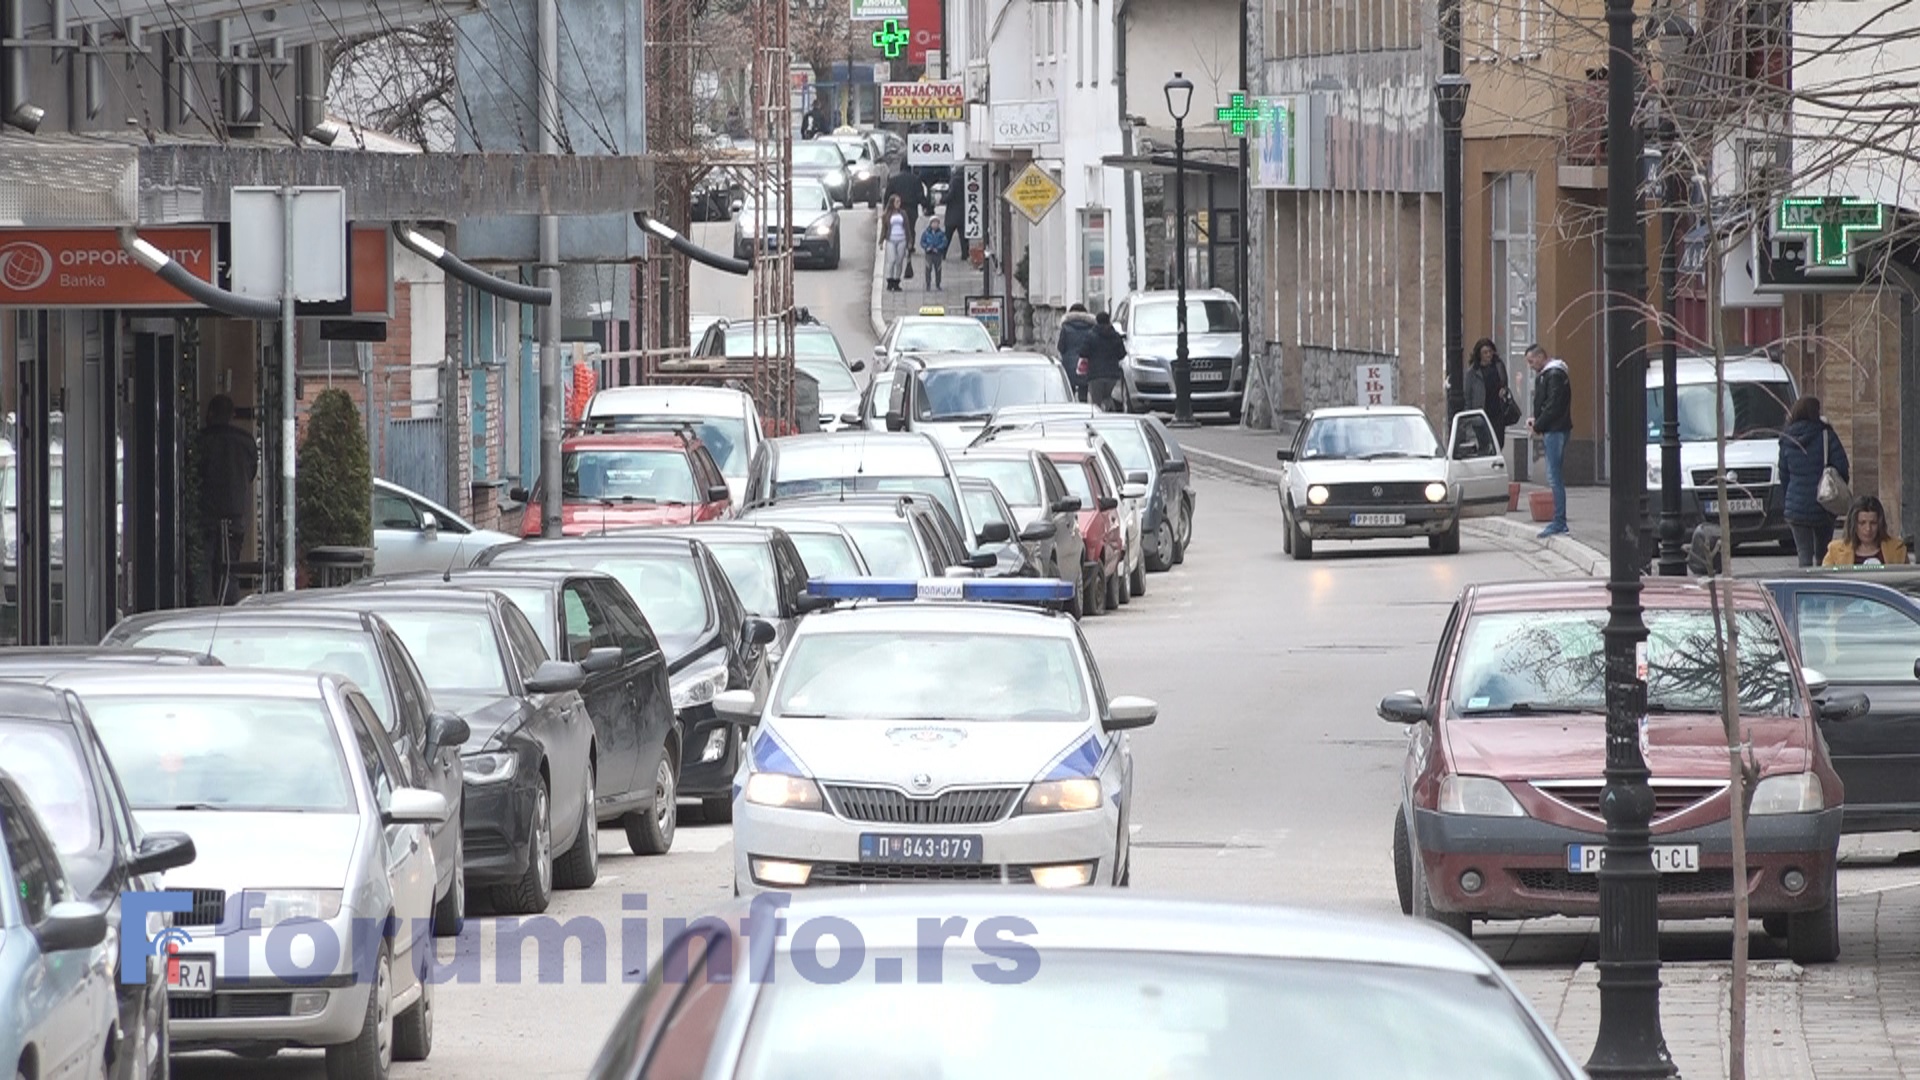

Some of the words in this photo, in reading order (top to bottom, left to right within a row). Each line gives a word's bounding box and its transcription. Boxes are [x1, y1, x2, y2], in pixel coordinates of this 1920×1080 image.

[883, 83, 962, 96] MENJAČNICA
[999, 122, 1051, 135] GRAND
[912, 143, 953, 153] KORA
[967, 171, 979, 225] KORAK
[60, 273, 105, 287] Banka
[918, 585, 962, 596] ПОЛИЦИЈА
